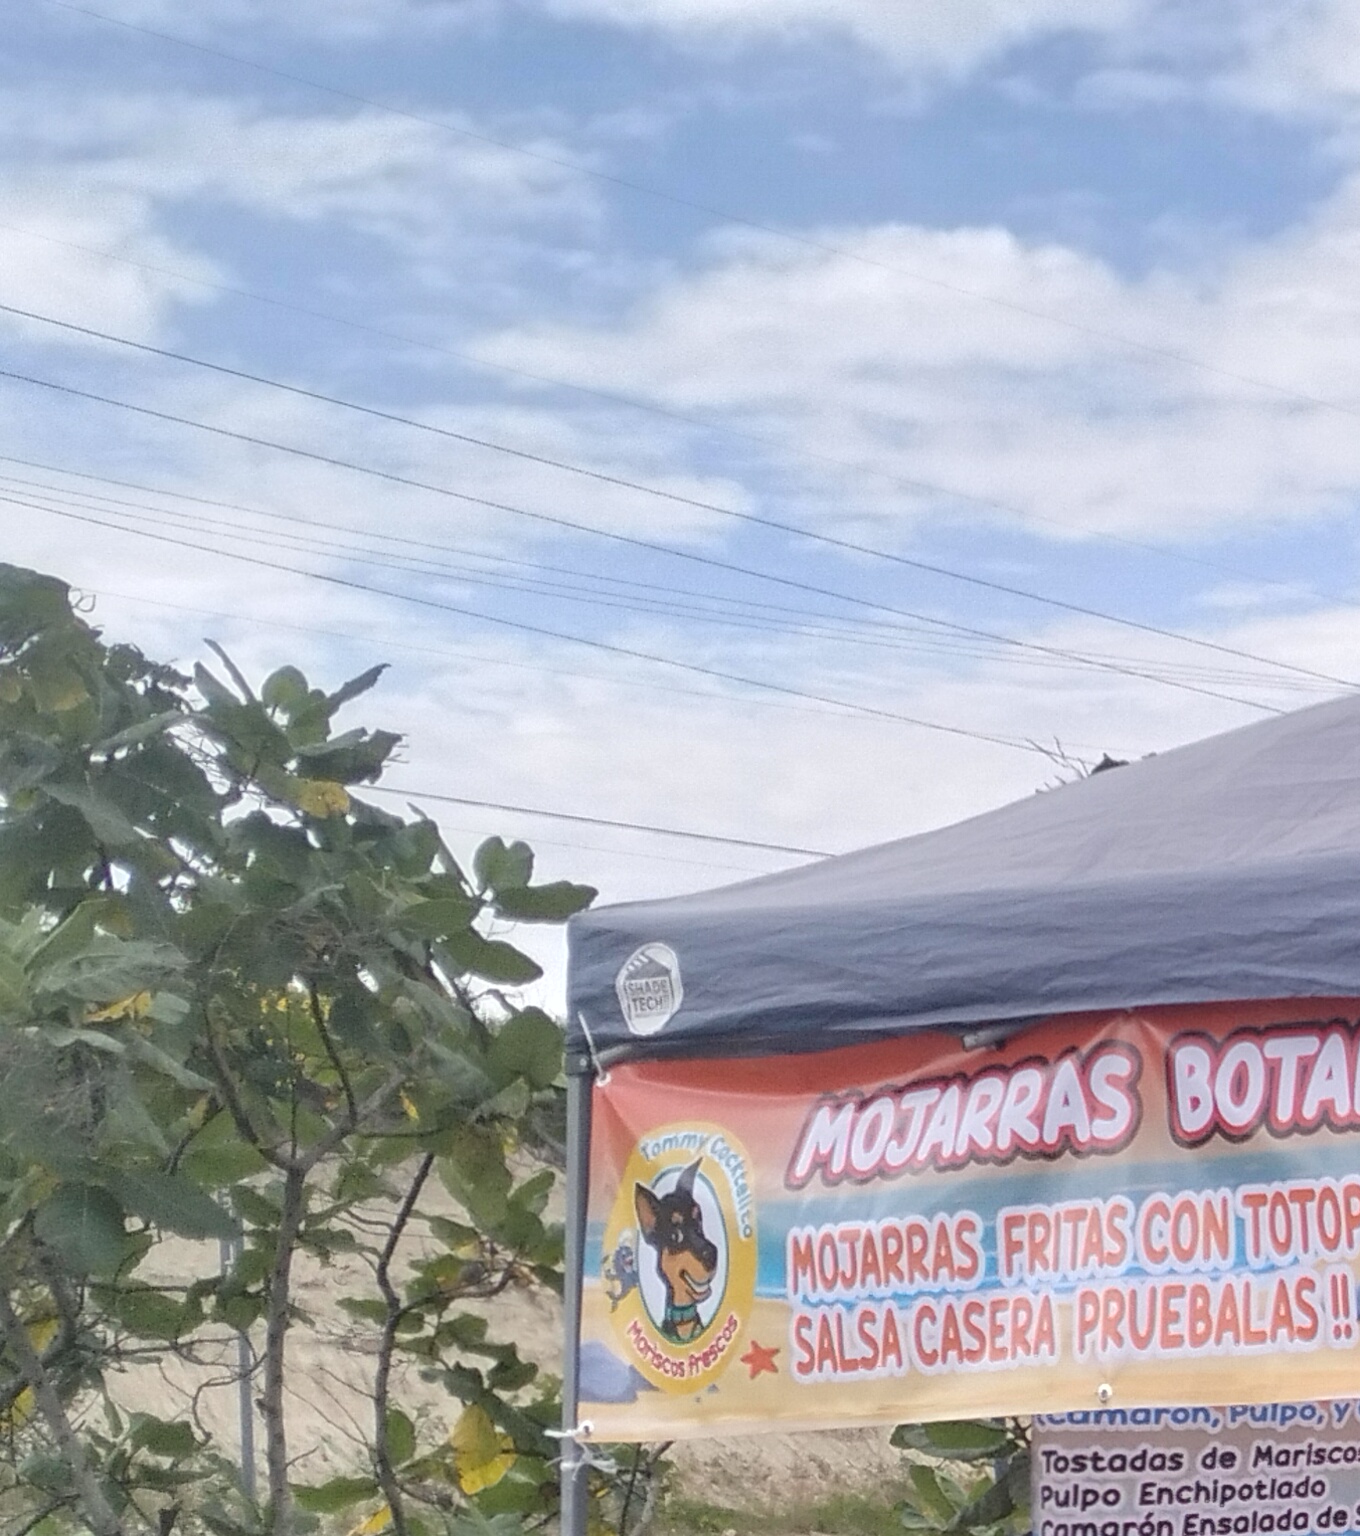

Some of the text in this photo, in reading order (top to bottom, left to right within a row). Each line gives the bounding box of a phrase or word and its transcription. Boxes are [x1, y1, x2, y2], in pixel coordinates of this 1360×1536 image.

[790, 1048, 1138, 1184] MOJARRAS
[640, 1131, 709, 1162] Tommy
[791, 1218, 983, 1296] MOJARRAS
[1002, 1204, 1127, 1279] FRITAS
[1141, 1194, 1231, 1264] CON
[626, 1319, 686, 1378] Mariscos
[792, 1307, 901, 1377] SALSA
[914, 1294, 1056, 1368] CASERA
[1229, 1403, 1326, 1426] Pulpo,
[1333, 1401, 1350, 1423] y
[1040, 1448, 1186, 1475] Tostadas
[1200, 1446, 1239, 1471] de
[1040, 1475, 1327, 1512] Pulpo Enchipotlado
[1316, 1506, 1349, 1530] de
